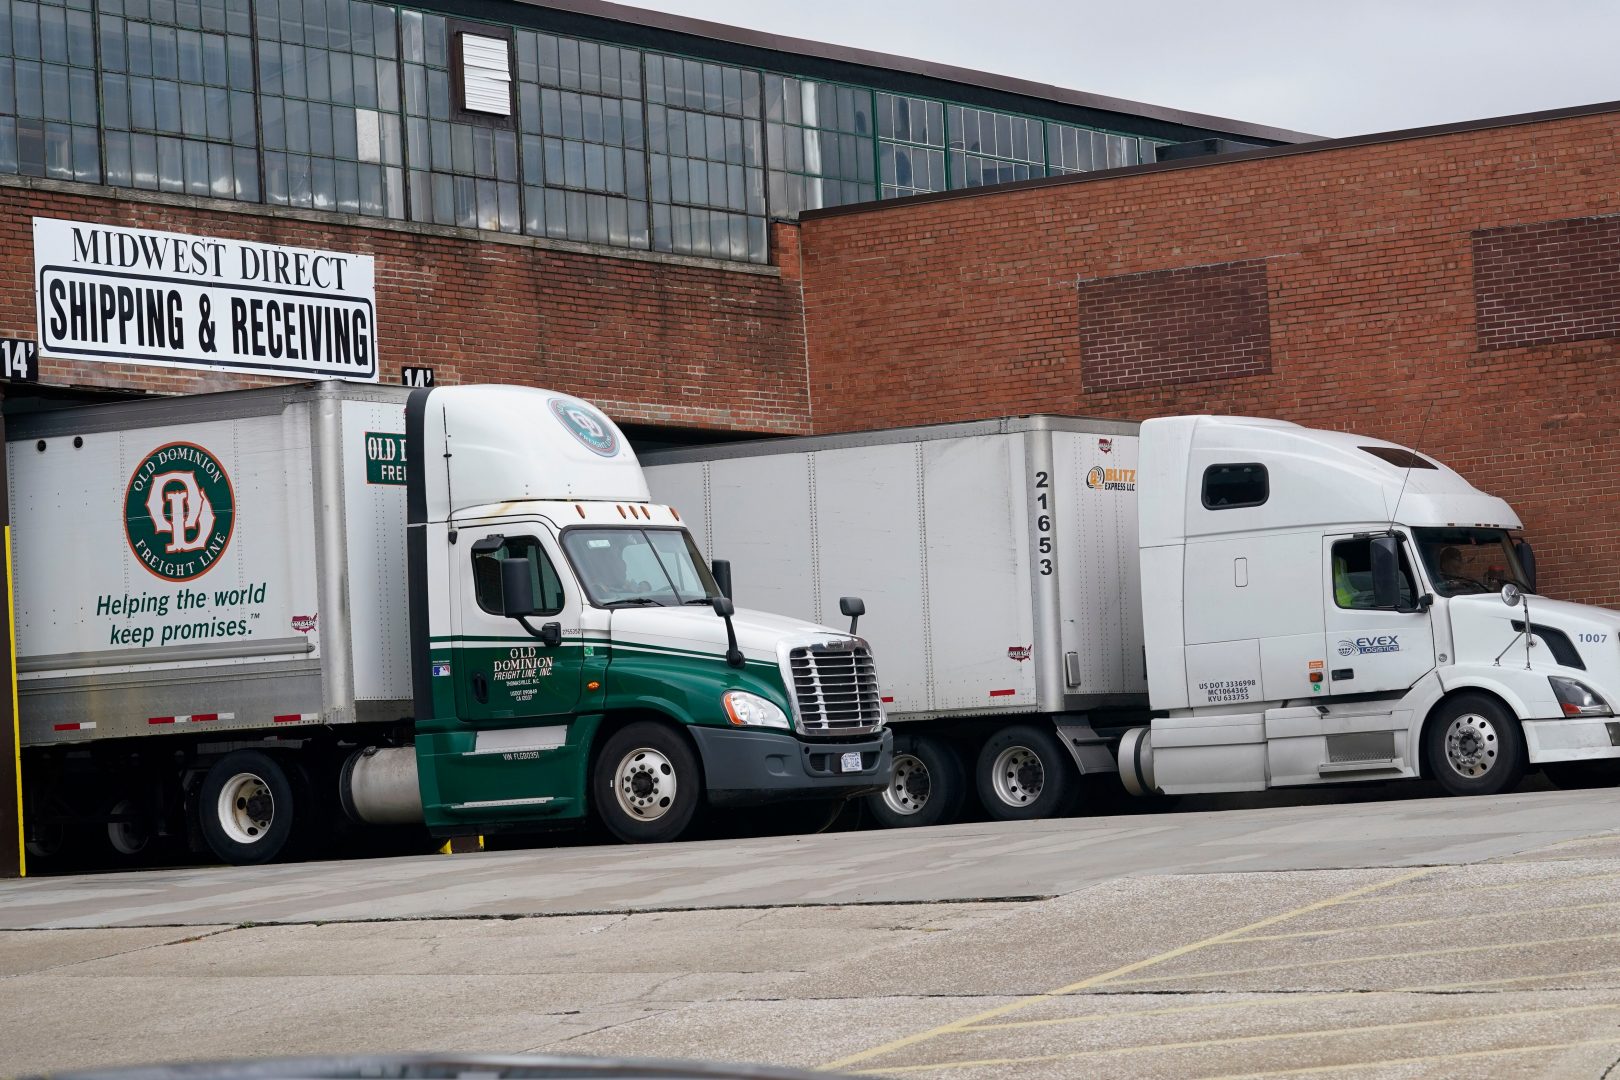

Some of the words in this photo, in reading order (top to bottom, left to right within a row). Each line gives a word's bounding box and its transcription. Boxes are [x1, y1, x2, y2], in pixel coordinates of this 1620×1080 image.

[72, 227, 226, 278] MIDWEST
[239, 245, 348, 291] DIRECT
[49, 278, 184, 350] SHIPPING
[198, 293, 217, 353] &
[231, 296, 369, 366] RECEIVING
[1, 340, 34, 379] 14'
[368, 436, 396, 461] OLD
[133, 461, 156, 491] OLD
[158, 448, 222, 484] DOMINION
[381, 465, 407, 481] FREI
[1105, 468, 1136, 483] BLITZ
[1105, 482, 1126, 491] EXPRESS
[1126, 483, 1136, 491] LLC
[135, 539, 195, 576] FREIGHT
[199, 532, 226, 567] LINE
[96, 592, 170, 618] Helping
[177, 588, 207, 610] the
[214, 582, 267, 605] world
[110, 624, 154, 647] keep
[161, 616, 252, 646] promises.
[1578, 634, 1607, 643] 1007
[1356, 635, 1398, 646] EVEX
[510, 646, 536, 659] OLD
[494, 656, 554, 672] DOMINION
[494, 670, 520, 680] FREIGHT
[1210, 681, 1224, 689] DOT
